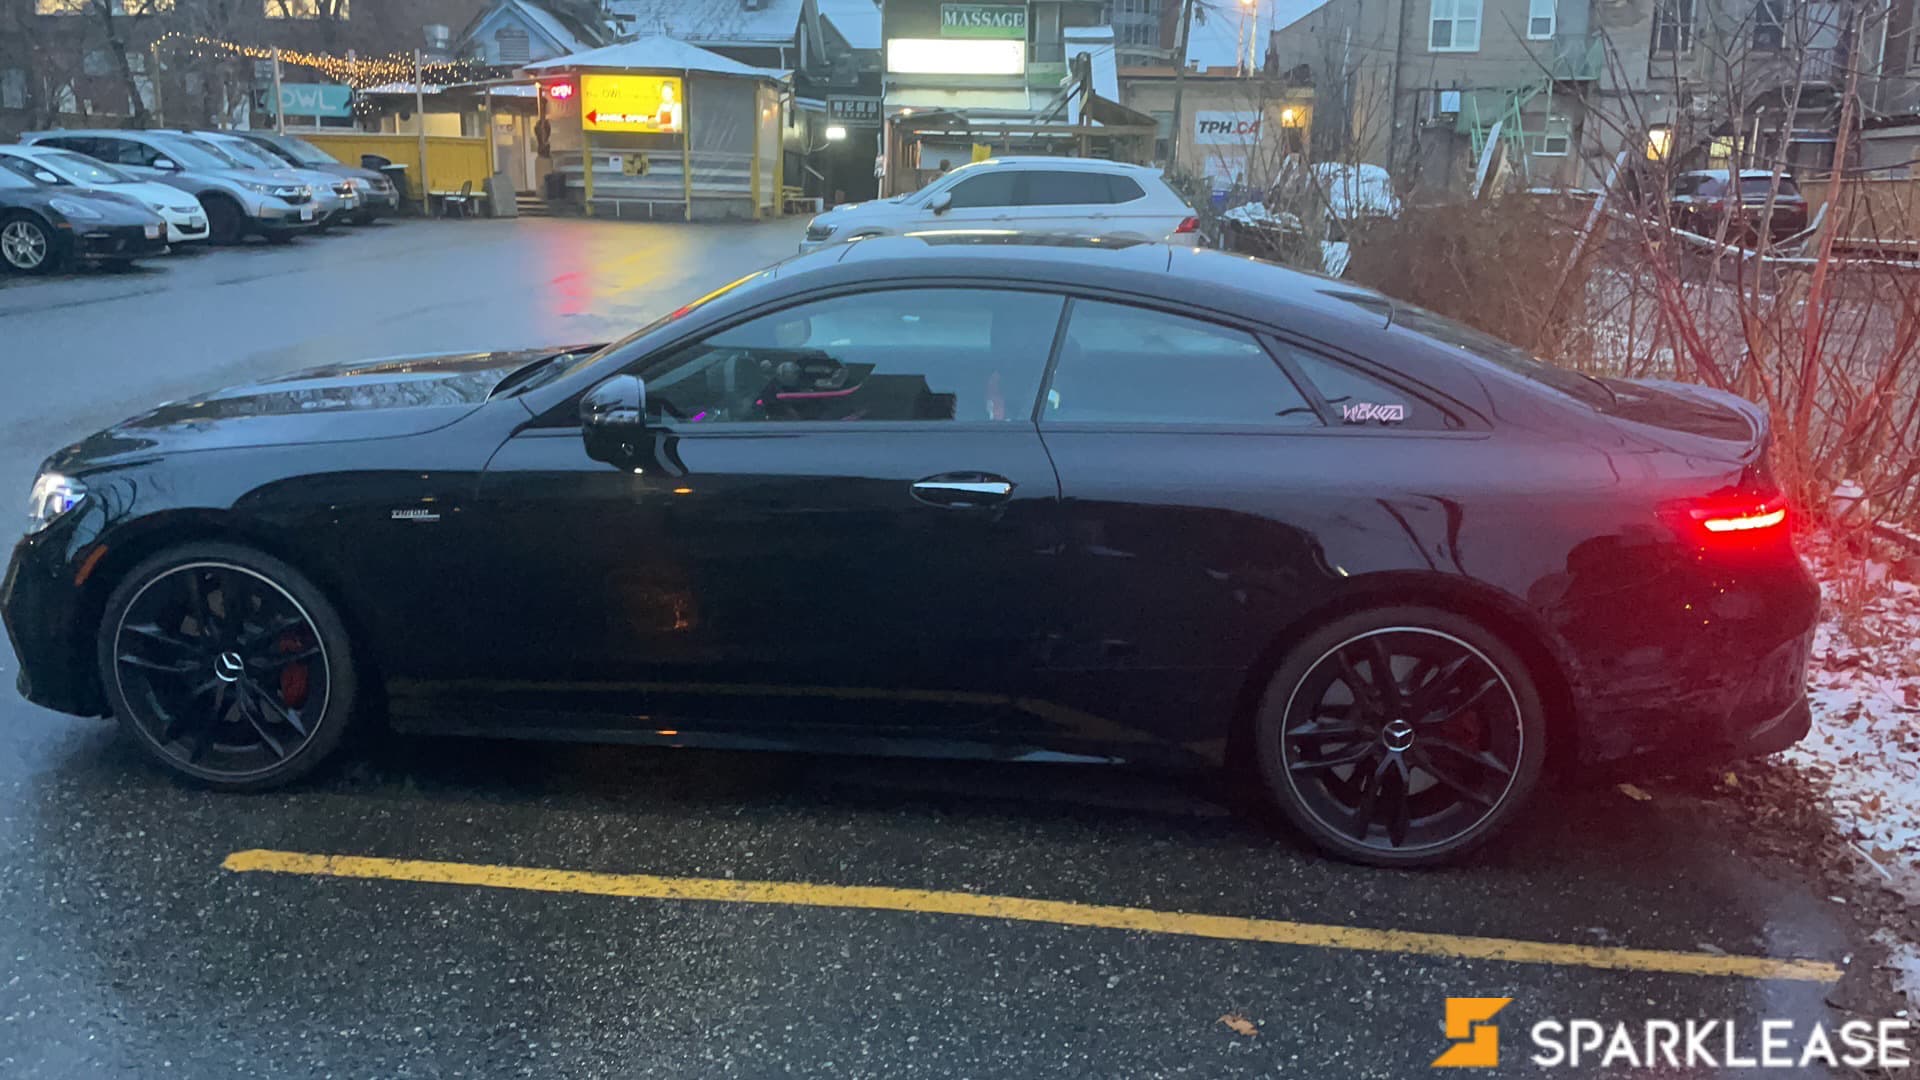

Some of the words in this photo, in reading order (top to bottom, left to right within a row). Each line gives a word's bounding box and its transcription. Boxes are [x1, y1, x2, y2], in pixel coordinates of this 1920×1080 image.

[944, 11, 1024, 27] MASSAGE
[550, 84, 573, 98] OPEN
[1199, 120, 1261, 134] TPH.CA
